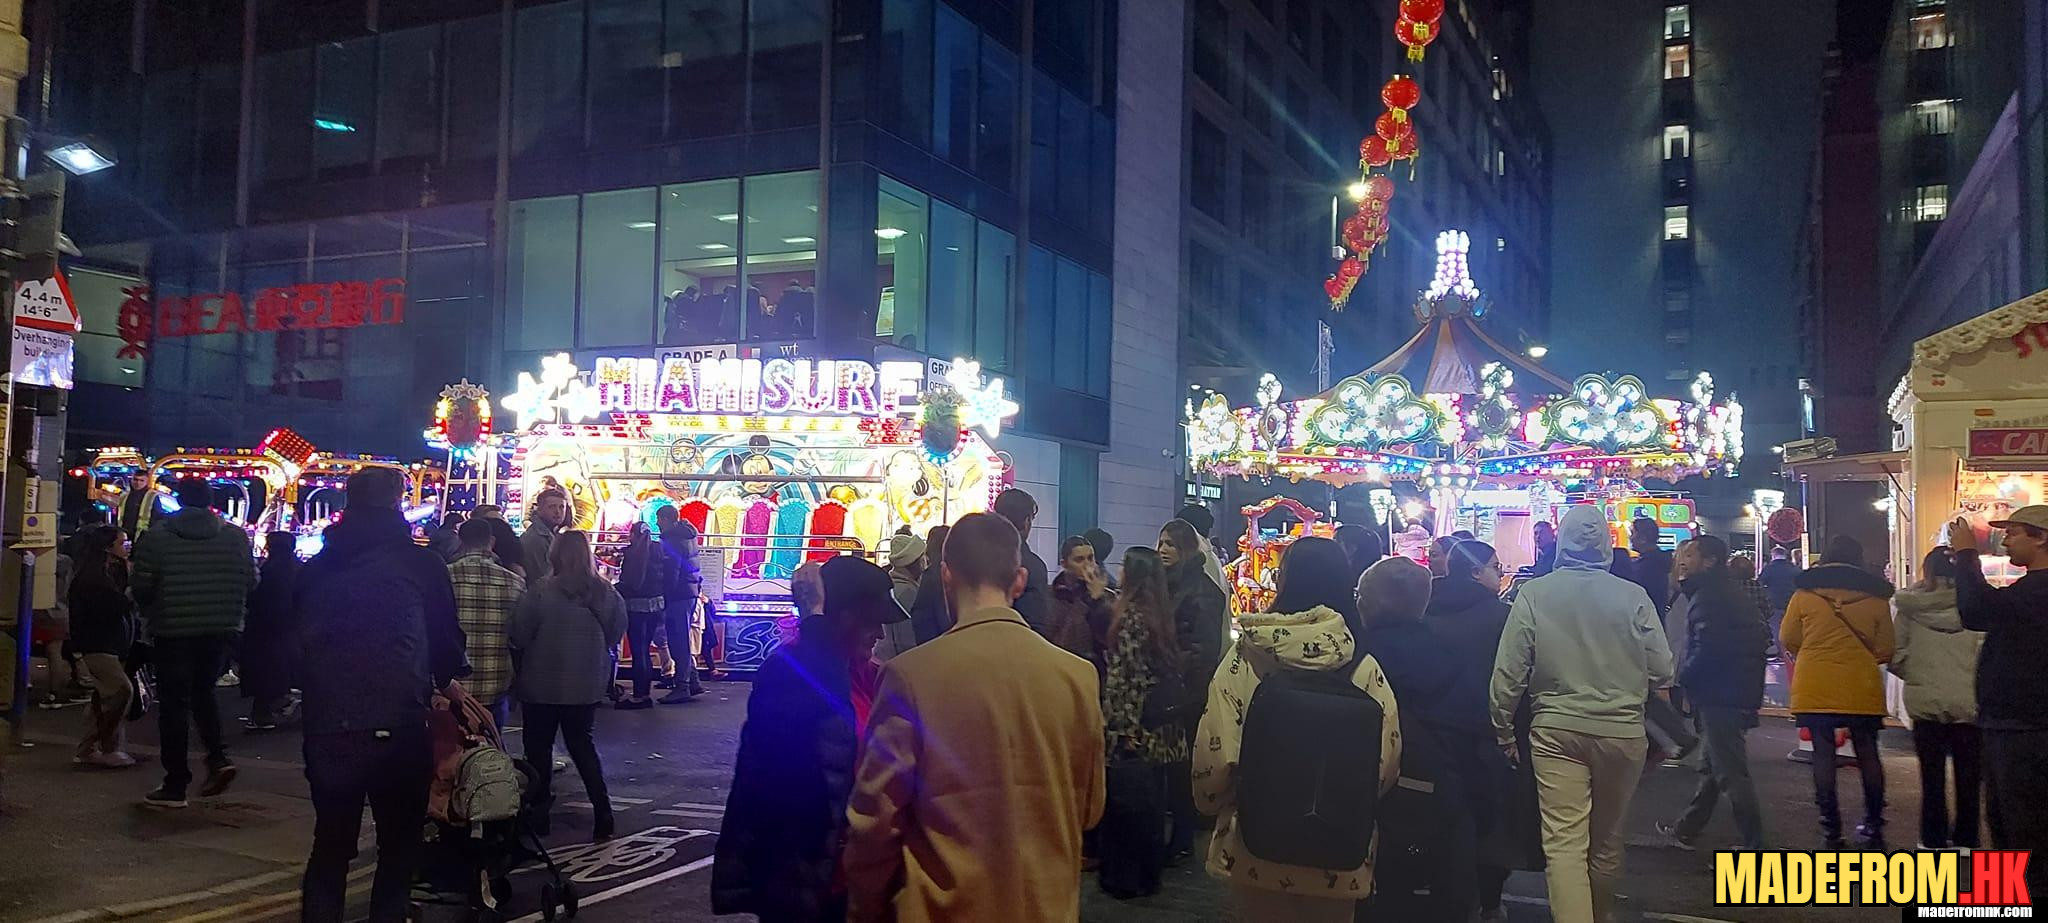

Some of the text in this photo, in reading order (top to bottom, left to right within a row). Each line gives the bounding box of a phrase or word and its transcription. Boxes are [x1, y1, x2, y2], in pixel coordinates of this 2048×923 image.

[21, 288, 62, 305] 4.4 m
[1187, 483, 1221, 498] MAHATTAN
